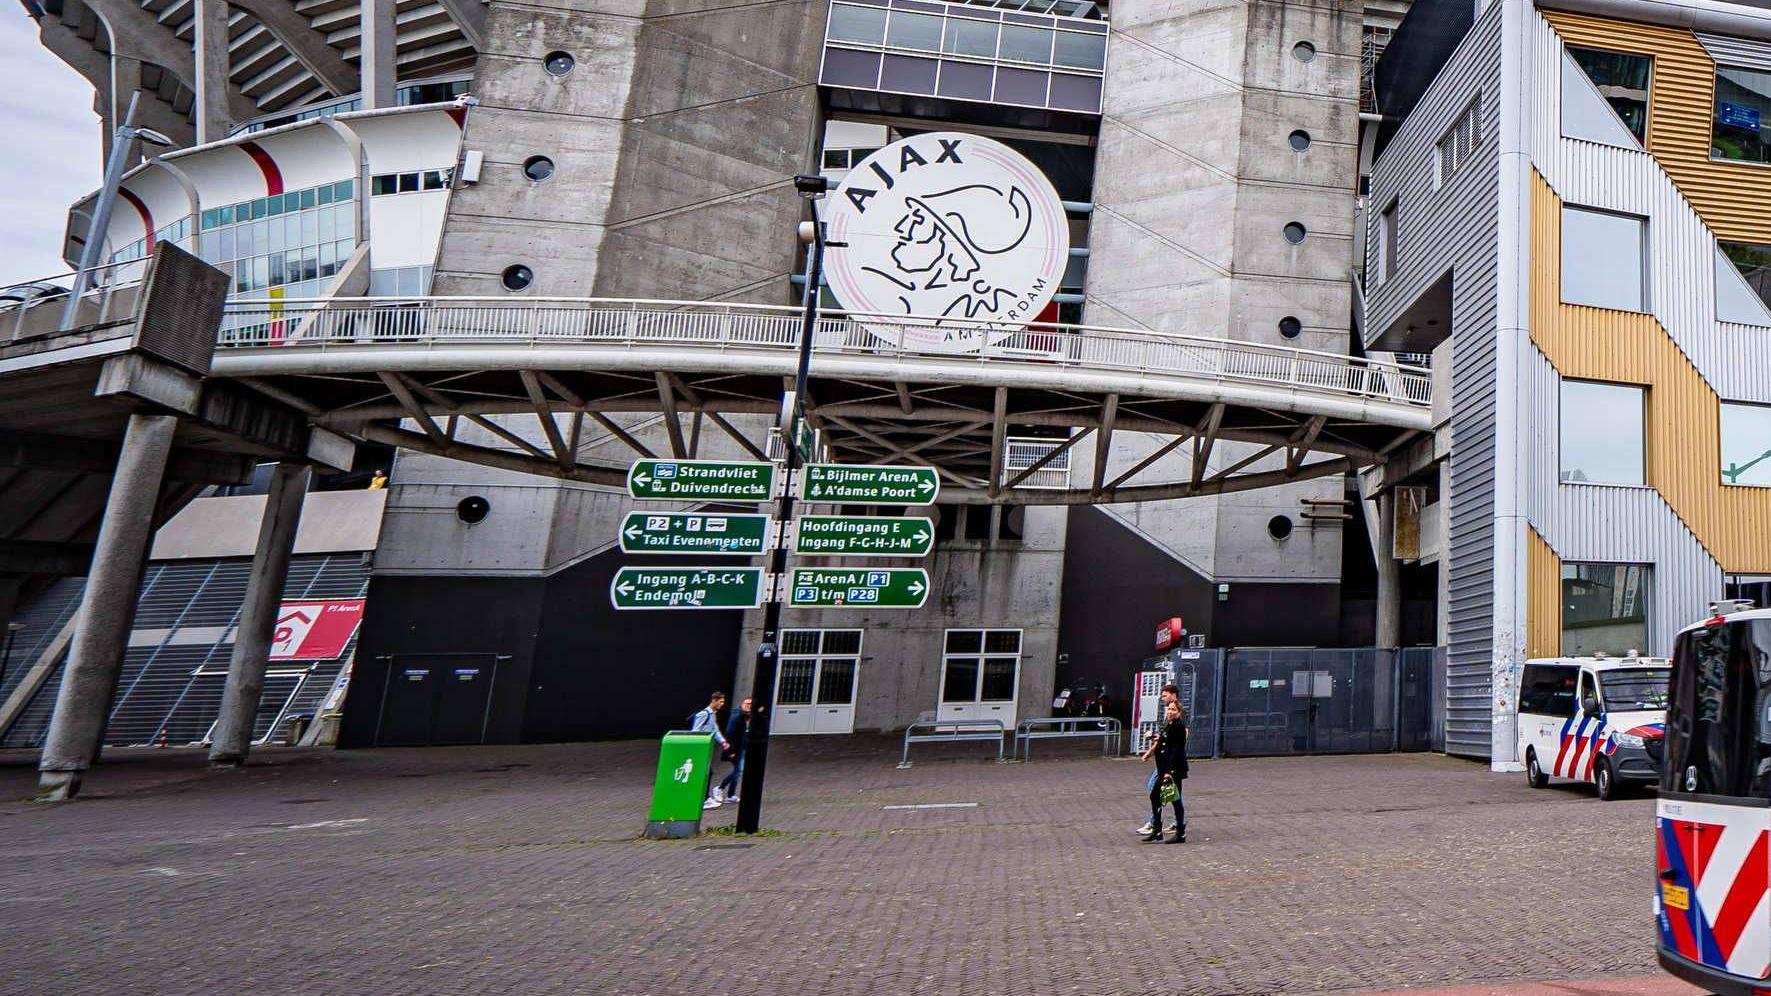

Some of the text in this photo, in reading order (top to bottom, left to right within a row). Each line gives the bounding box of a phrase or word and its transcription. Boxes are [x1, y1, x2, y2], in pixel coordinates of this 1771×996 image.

[845, 140, 963, 214] AJAX
[680, 467, 758, 479] Strandvliet
[826, 470, 918, 483] Bijlmer ArenA
[824, 486, 916, 497] A'damse Poort
[690, 519, 698, 528] P
[802, 521, 901, 535] Hoofdingang E
[643, 534, 760, 547] Taxi Evenementen
[800, 536, 912, 549] Ingang F-G-H-J-M
[636, 573, 746, 587] Ingang A-B-C-K
[814, 574, 856, 584] ArenA
[870, 574, 886, 584] P1
[798, 589, 875, 600] P3 t/m P28
